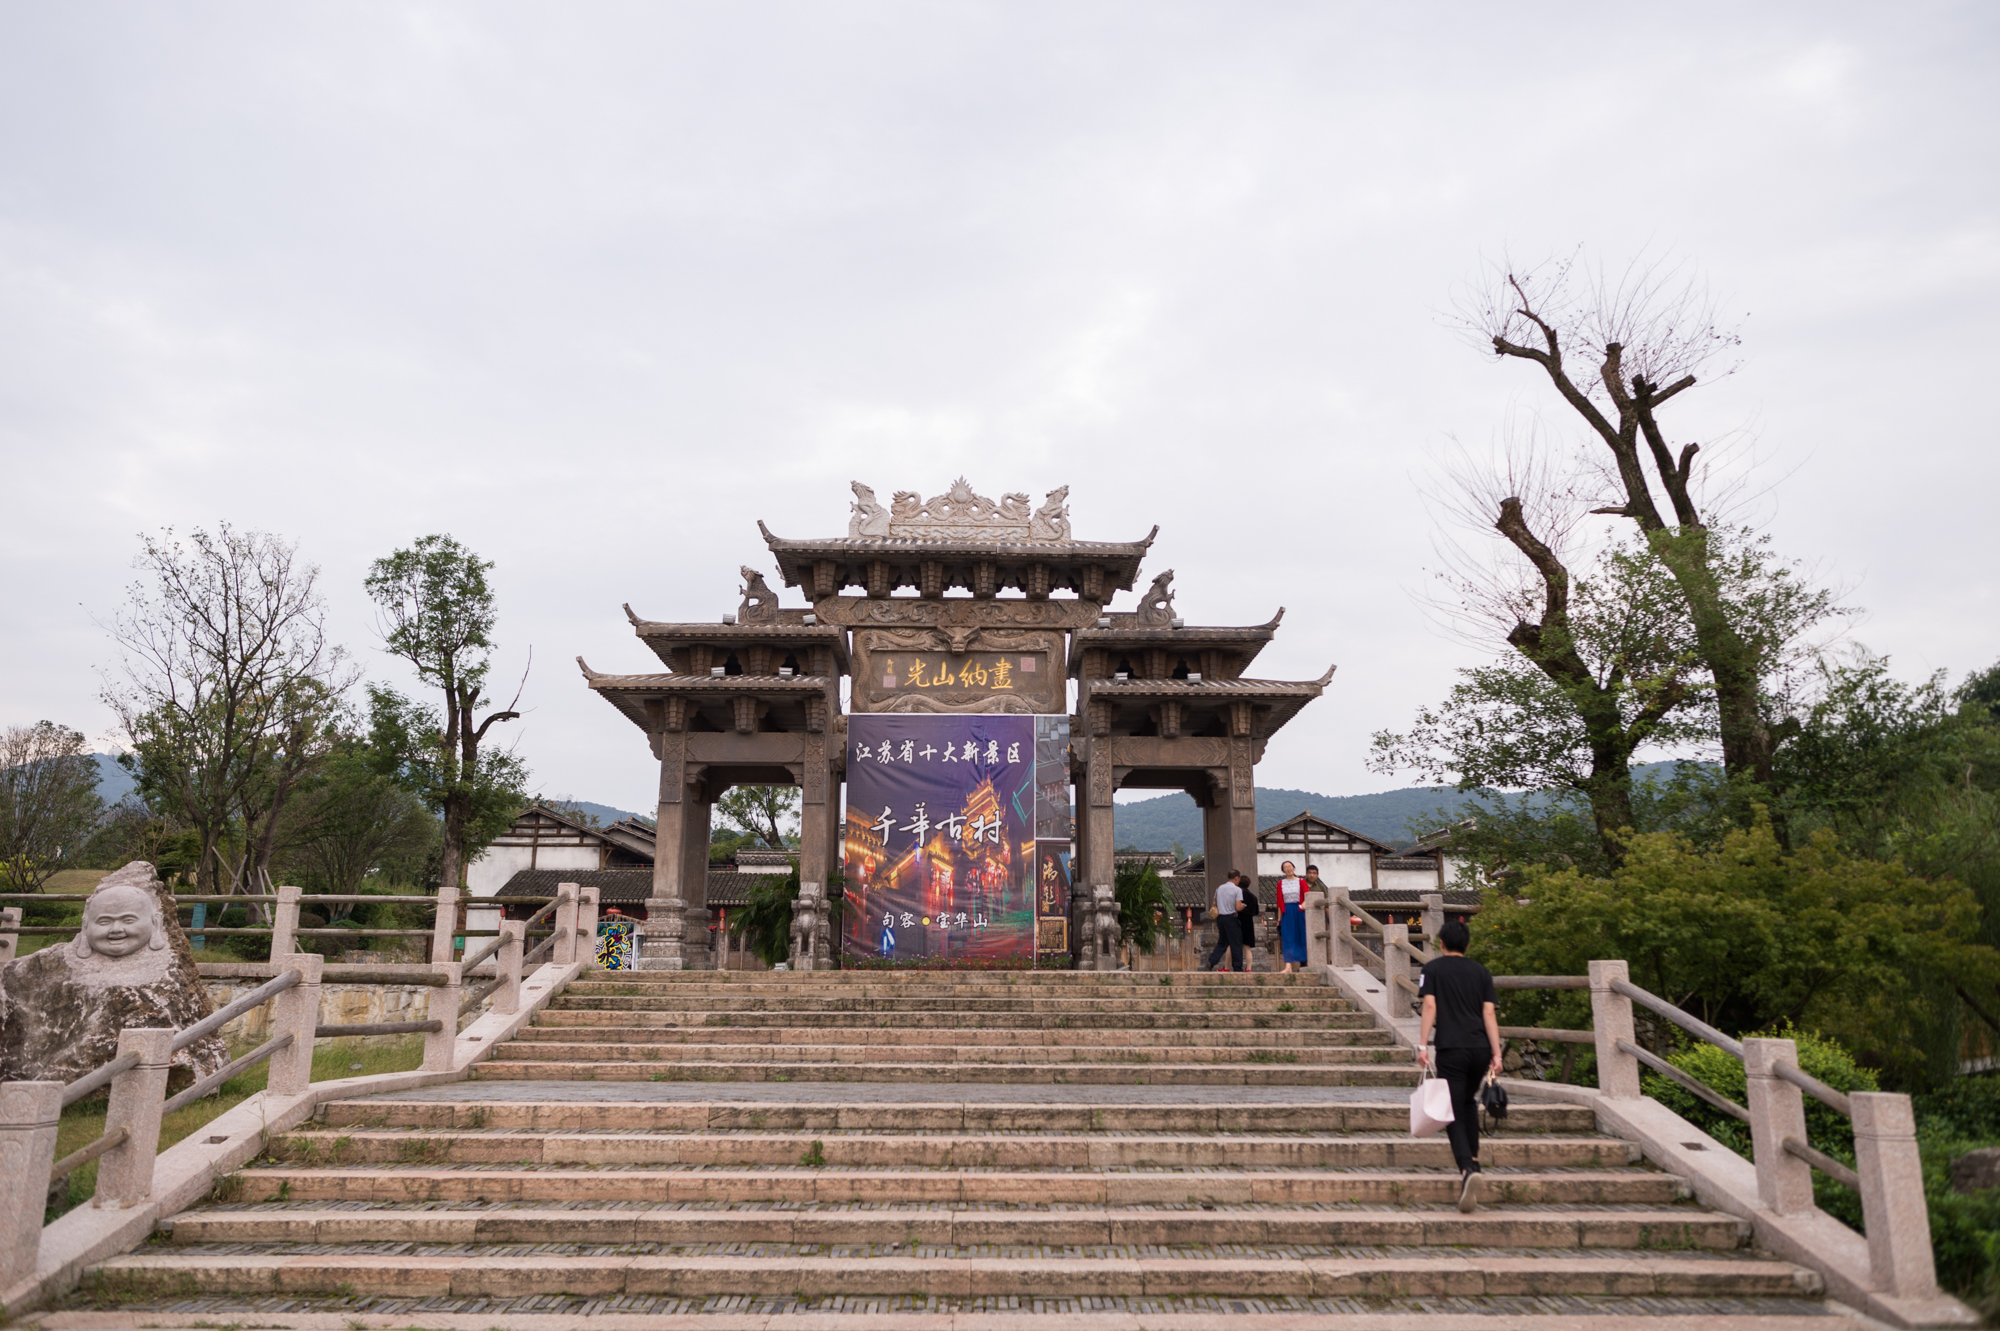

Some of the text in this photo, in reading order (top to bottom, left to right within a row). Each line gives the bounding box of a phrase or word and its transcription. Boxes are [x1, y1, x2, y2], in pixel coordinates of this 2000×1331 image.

[856, 739, 1021, 765] 江苏省十大新景区
